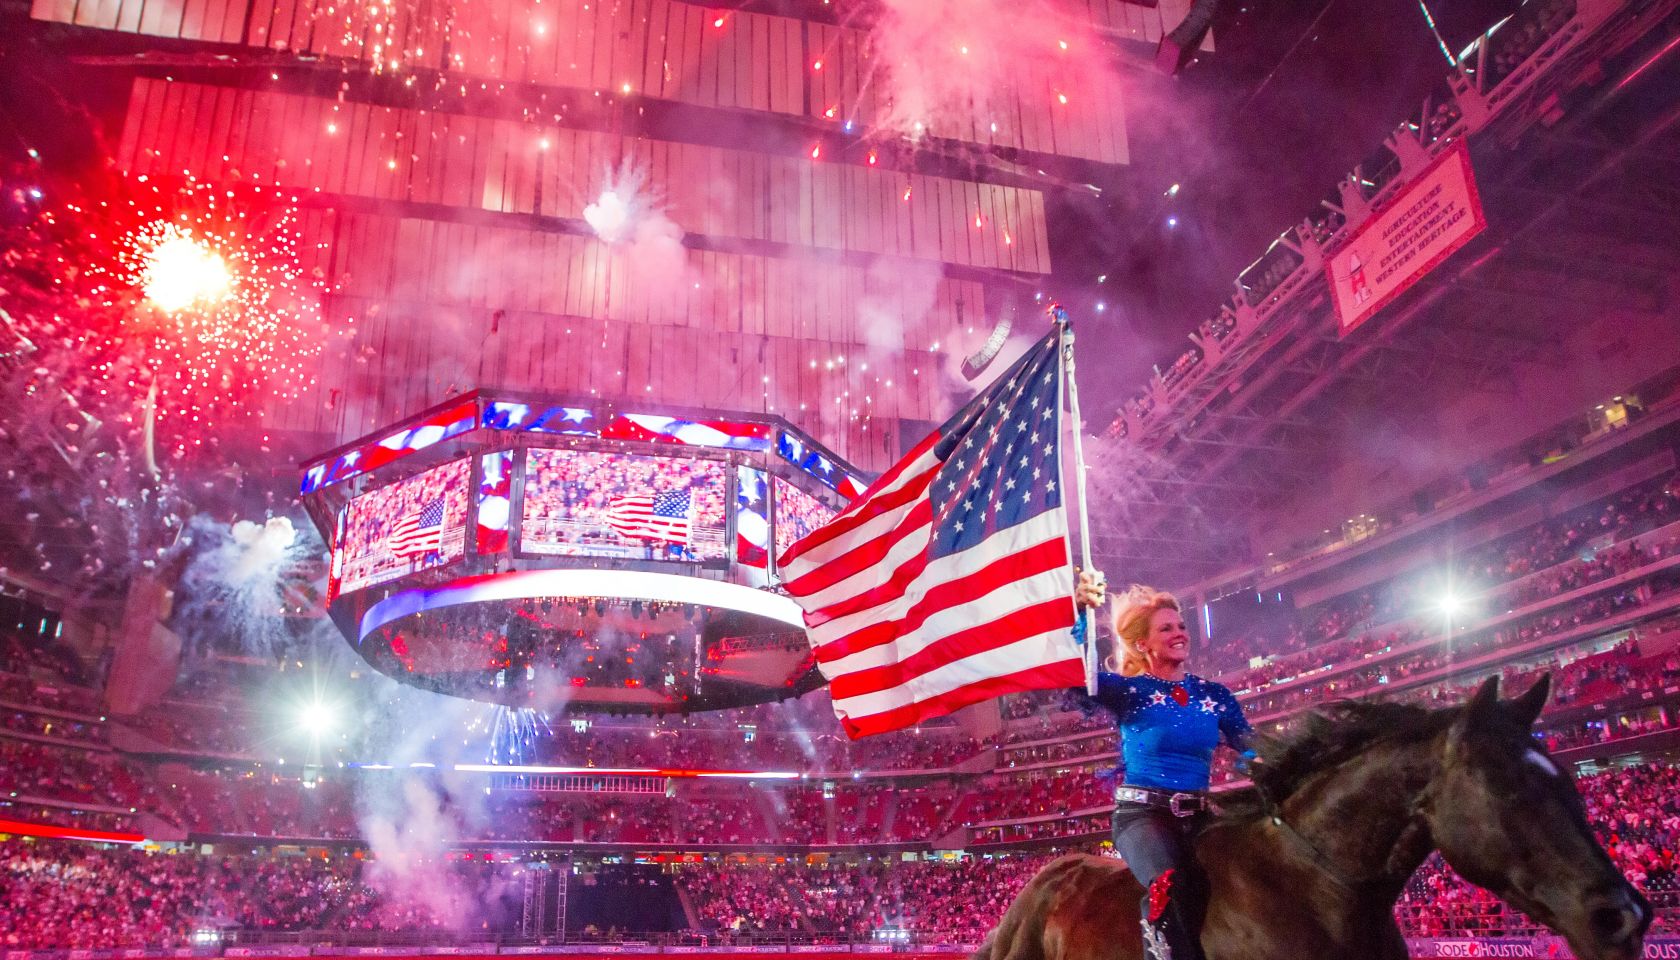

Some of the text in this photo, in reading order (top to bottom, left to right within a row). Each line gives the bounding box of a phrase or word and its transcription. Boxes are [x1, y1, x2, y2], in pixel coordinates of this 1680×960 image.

[1380, 201, 1455, 268] ENTERTAINMENT
[1382, 183, 1442, 240] AGRICULTURE
[1389, 201, 1440, 248] EDUCATION
[1376, 207, 1466, 285] WESTERN HERITAGE
